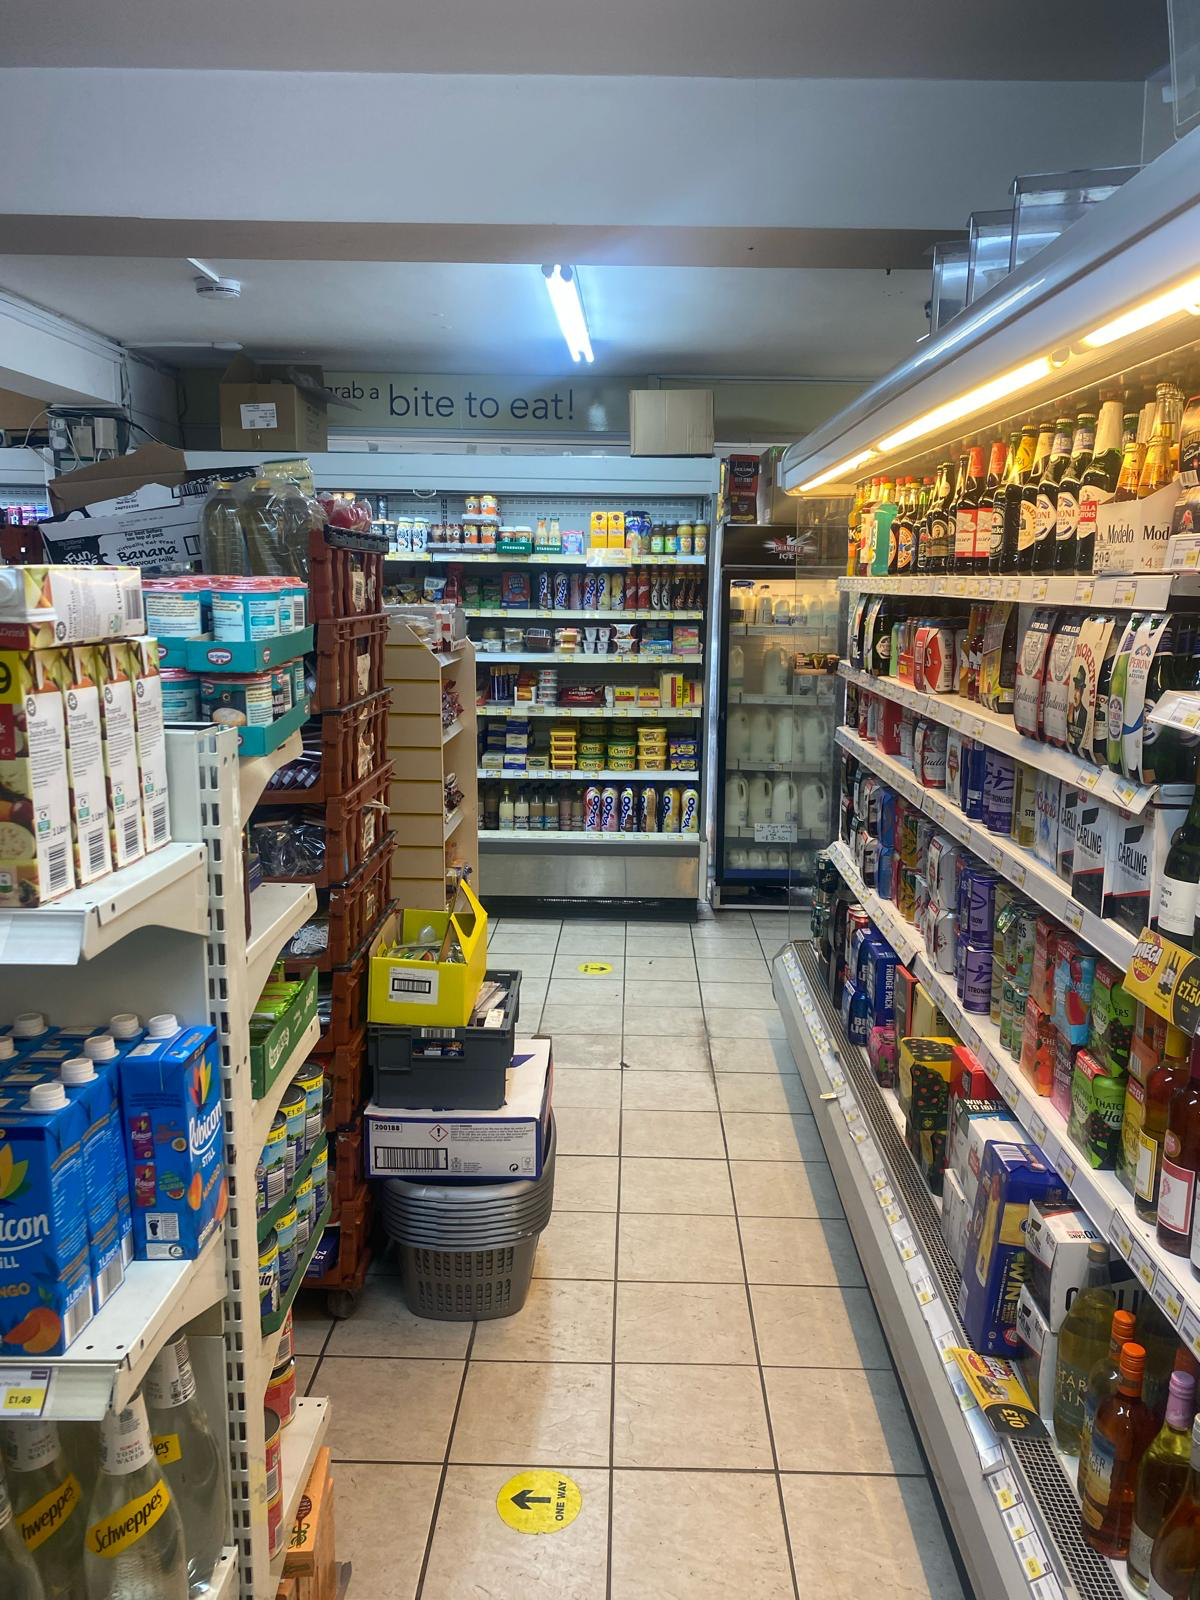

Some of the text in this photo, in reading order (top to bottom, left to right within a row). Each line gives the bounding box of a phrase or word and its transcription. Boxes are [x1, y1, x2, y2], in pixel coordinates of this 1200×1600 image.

[370, 388, 379, 400] a
[389, 384, 574, 420] bite to eat!
[1107, 524, 1135, 544] Modelo
[1143, 526, 1170, 541] Mod
[117, 545, 180, 562] Banana
[587, 795, 600, 828] YAZOO
[682, 797, 696, 829] YAZOO
[1061, 807, 1077, 830] CARLI
[1076, 824, 1102, 853] CARLING
[1118, 842, 1148, 876] CARLING
[1132, 942, 1164, 967] MEGA
[885, 965, 894, 1009] FRIDGE PACK
[963, 1098, 984, 1106] WIN
[1095, 1098, 1125, 1110] THATC
[1100, 1109, 1120, 1123] Ha
[189, 1100, 222, 1162] Rubicon
[374, 1123, 400, 1132] 200188
[202, 1150, 216, 1168] STILL
[0, 1213, 50, 1242] icon
[0, 1256, 19, 1269] ILL
[0, 1282, 31, 1298] NGO
[8, 1396, 32, 1404] £1.49
[1002, 1408, 1025, 1429] £10
[22, 1482, 75, 1541] hweppes
[555, 1480, 567, 1521] ONE WAY
[94, 1487, 163, 1553] Schweppes
